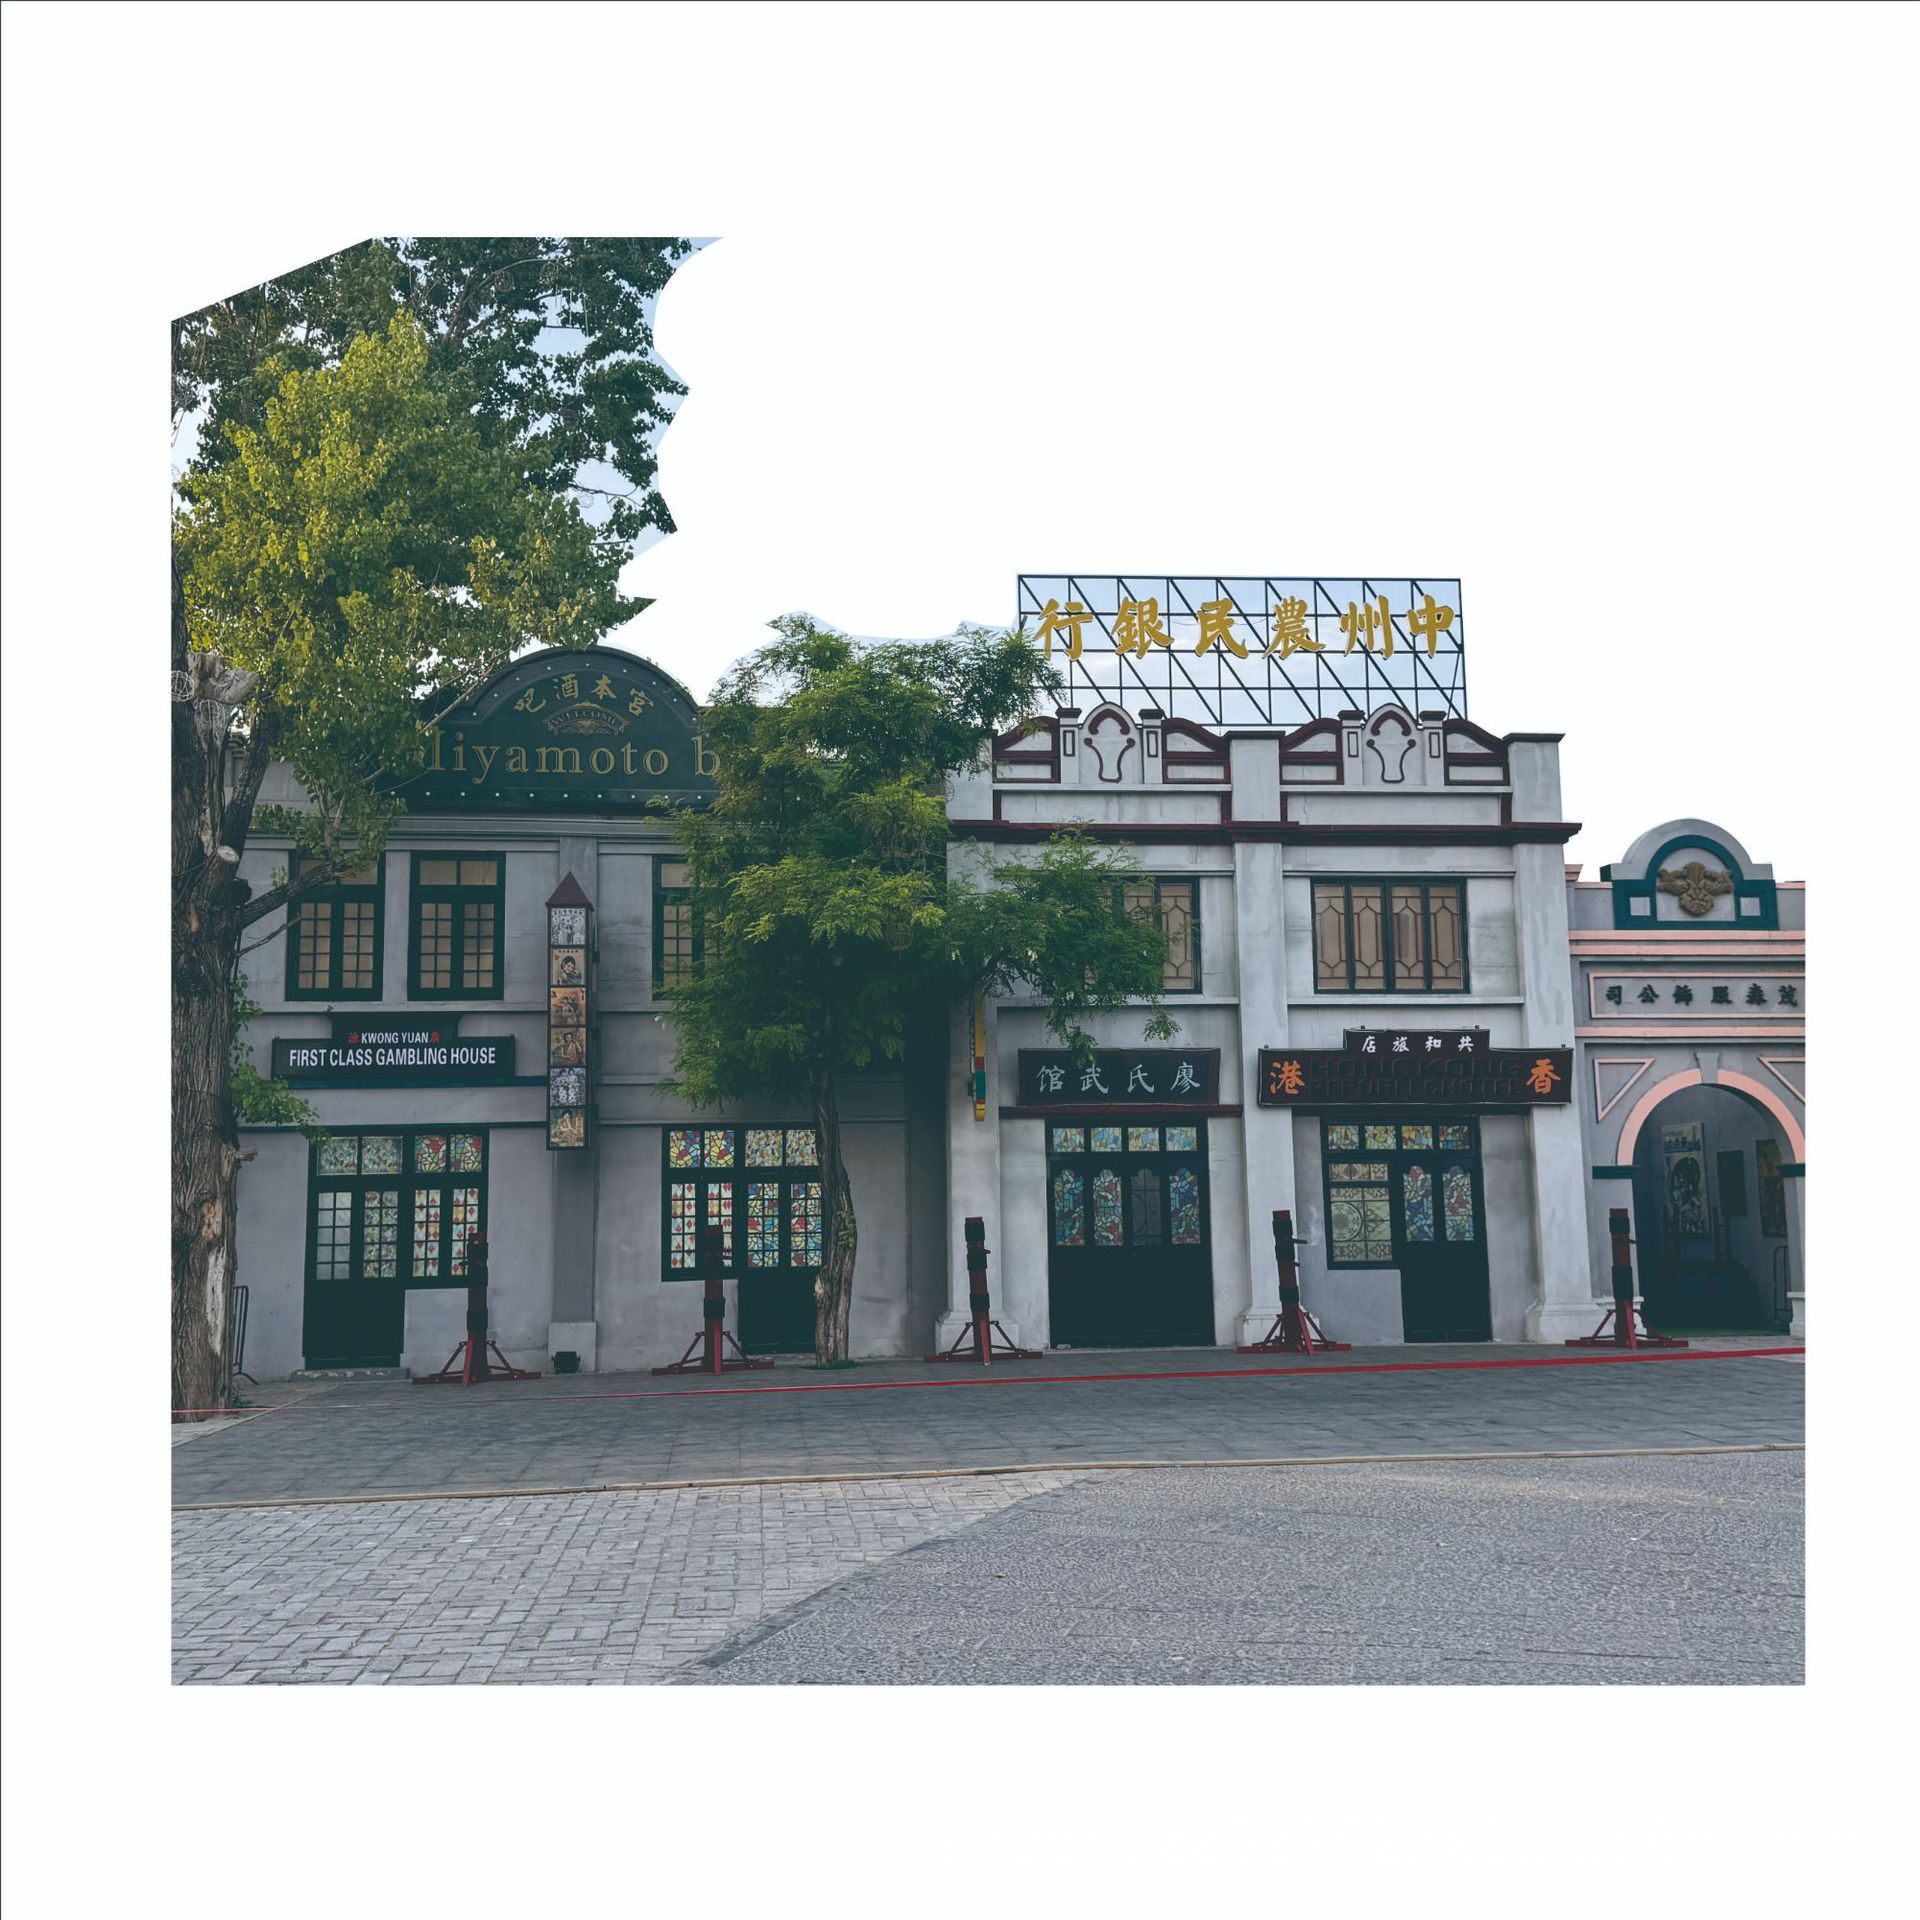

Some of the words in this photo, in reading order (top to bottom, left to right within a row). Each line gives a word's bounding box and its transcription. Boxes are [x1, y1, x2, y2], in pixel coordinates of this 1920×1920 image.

[361, 1032, 399, 1044] KWONG
[401, 1032, 429, 1044] YUAN
[289, 1049, 327, 1067] FIRST
[329, 1048, 373, 1067] CLASS
[376, 1048, 447, 1066] GAMBLING
[450, 1047, 496, 1065] HOUSE
